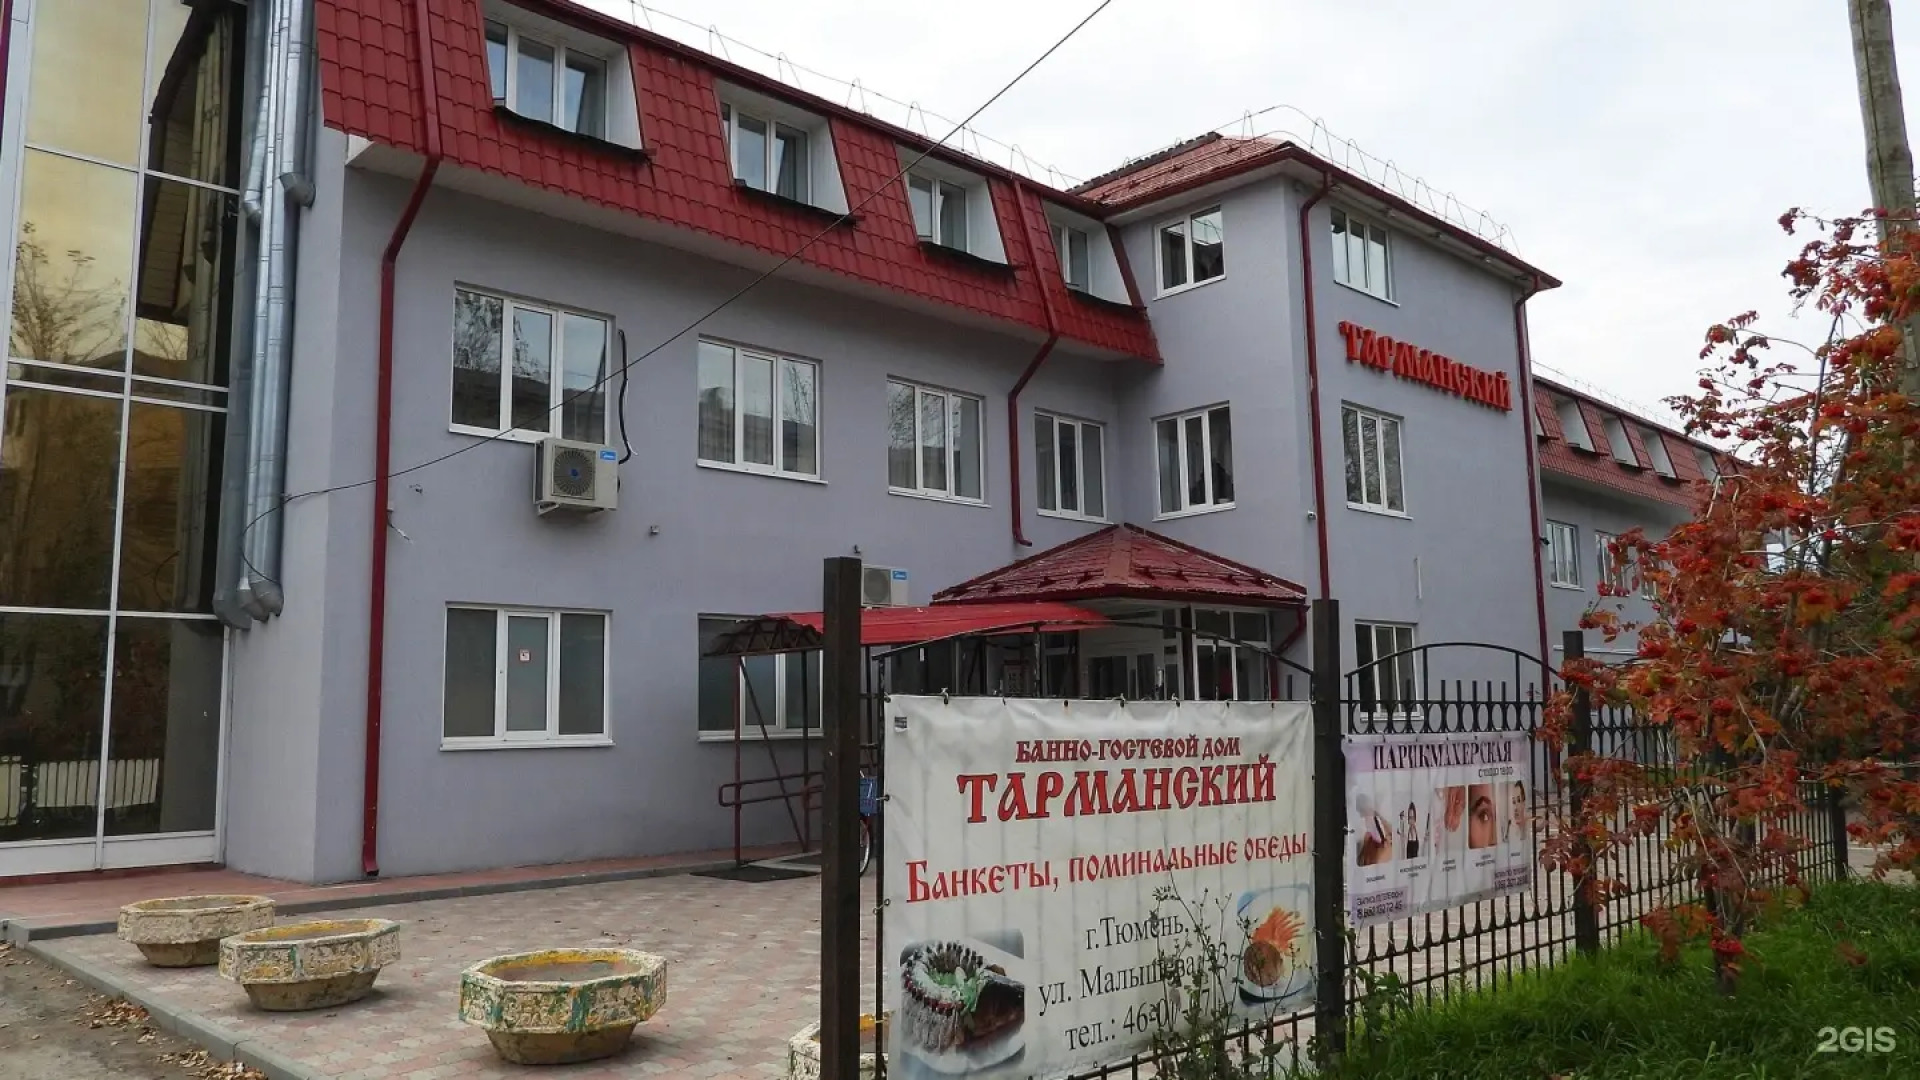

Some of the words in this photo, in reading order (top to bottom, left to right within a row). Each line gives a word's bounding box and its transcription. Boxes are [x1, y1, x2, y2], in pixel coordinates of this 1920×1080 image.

[1339, 320, 1512, 411] ТАРМАНСКИЙ
[1015, 734, 1199, 763] БАННО-ГОСТЕВОЙ
[1202, 736, 1240, 761] ДОМ
[1374, 741, 1512, 770] ПАРИКМАХЕРСКАЯ
[956, 754, 1277, 823] ТАРМАНСКИЙ
[1038, 981, 1072, 1017] ул.
[1064, 1018, 1115, 1051] тел.:
